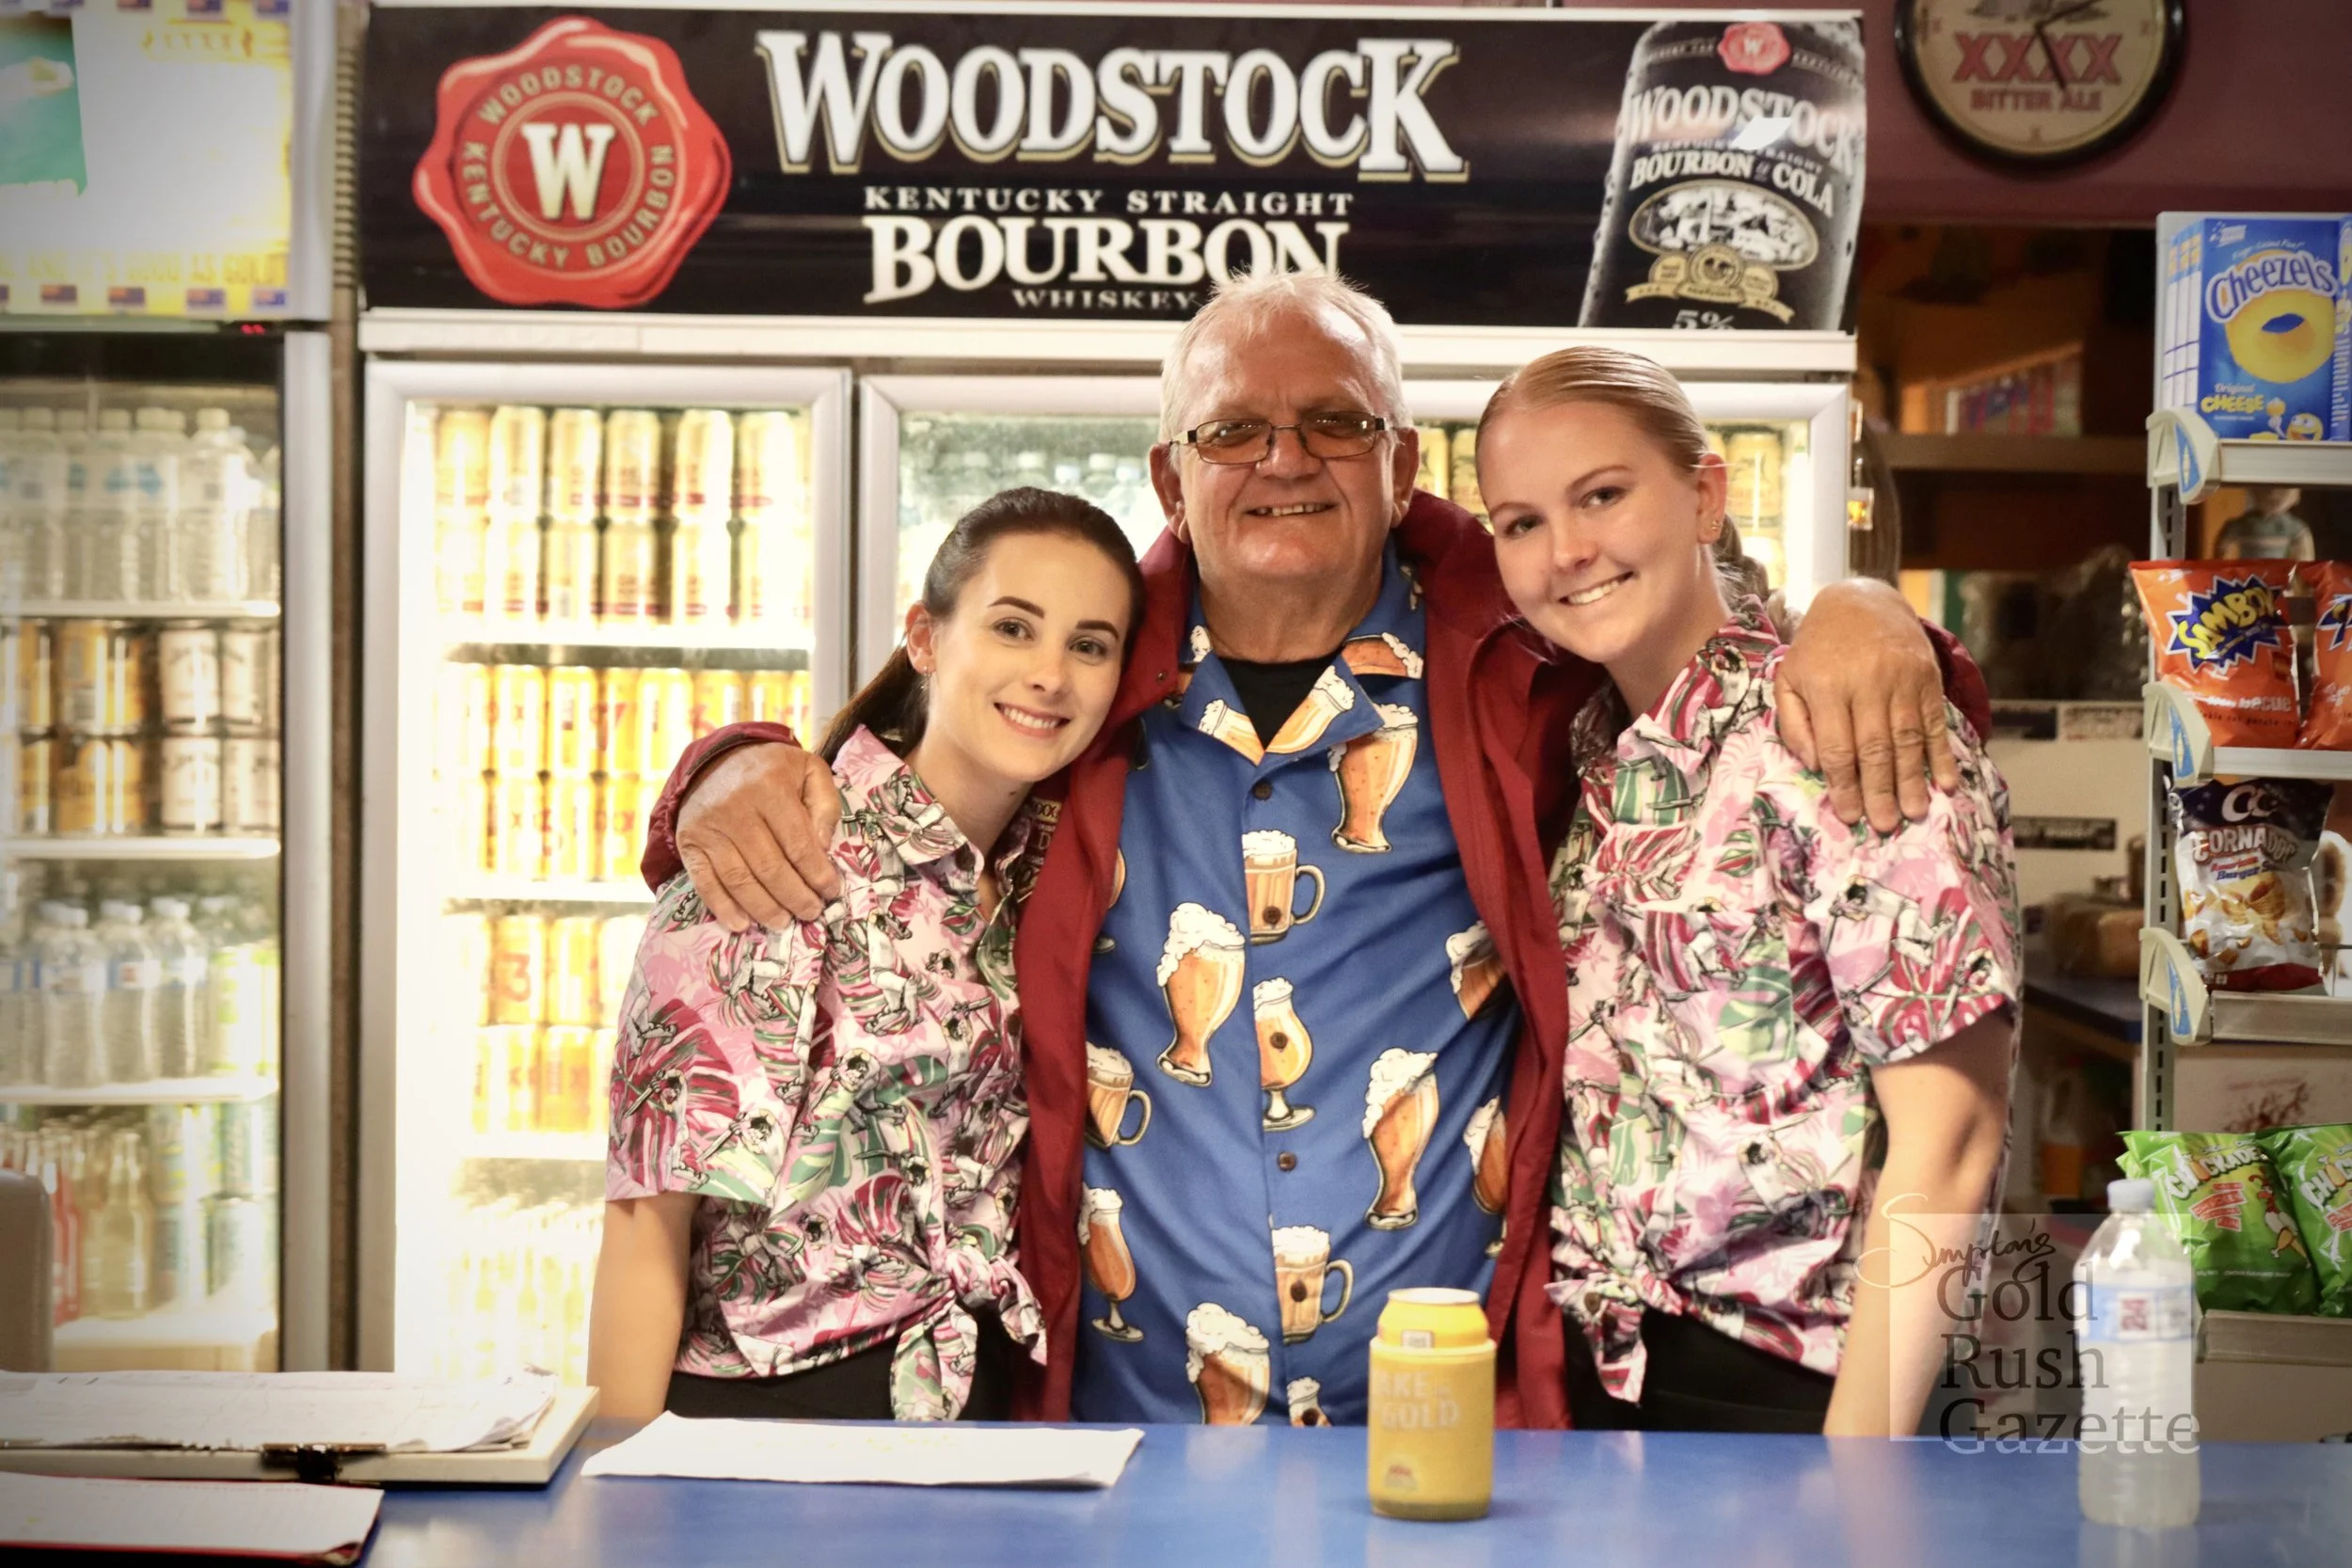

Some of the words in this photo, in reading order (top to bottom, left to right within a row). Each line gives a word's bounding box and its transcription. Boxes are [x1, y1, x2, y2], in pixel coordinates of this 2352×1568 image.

[1951, 31, 2122, 86] XXXX
[477, 64, 659, 126] WOODSTOCK
[755, 31, 1470, 182] WOODSTOCK
[1970, 88, 2052, 111] BITTER
[2059, 90, 2103, 112] ALE
[520, 122, 615, 221] W
[864, 187, 1104, 213] KENTUCKY
[1127, 190, 1355, 216] STRAIGHT
[1629, 150, 1756, 191] BOURBON
[1772, 164, 1835, 218] COLA
[461, 142, 570, 269] KENTUCKY
[585, 144, 675, 268] BOURBON
[861, 214, 1350, 304] BOURBON
[2208, 252, 2336, 322] Cheezels
[1010, 289, 1200, 311] WHISKEY
[1373, 1370, 1430, 1399] AKE
